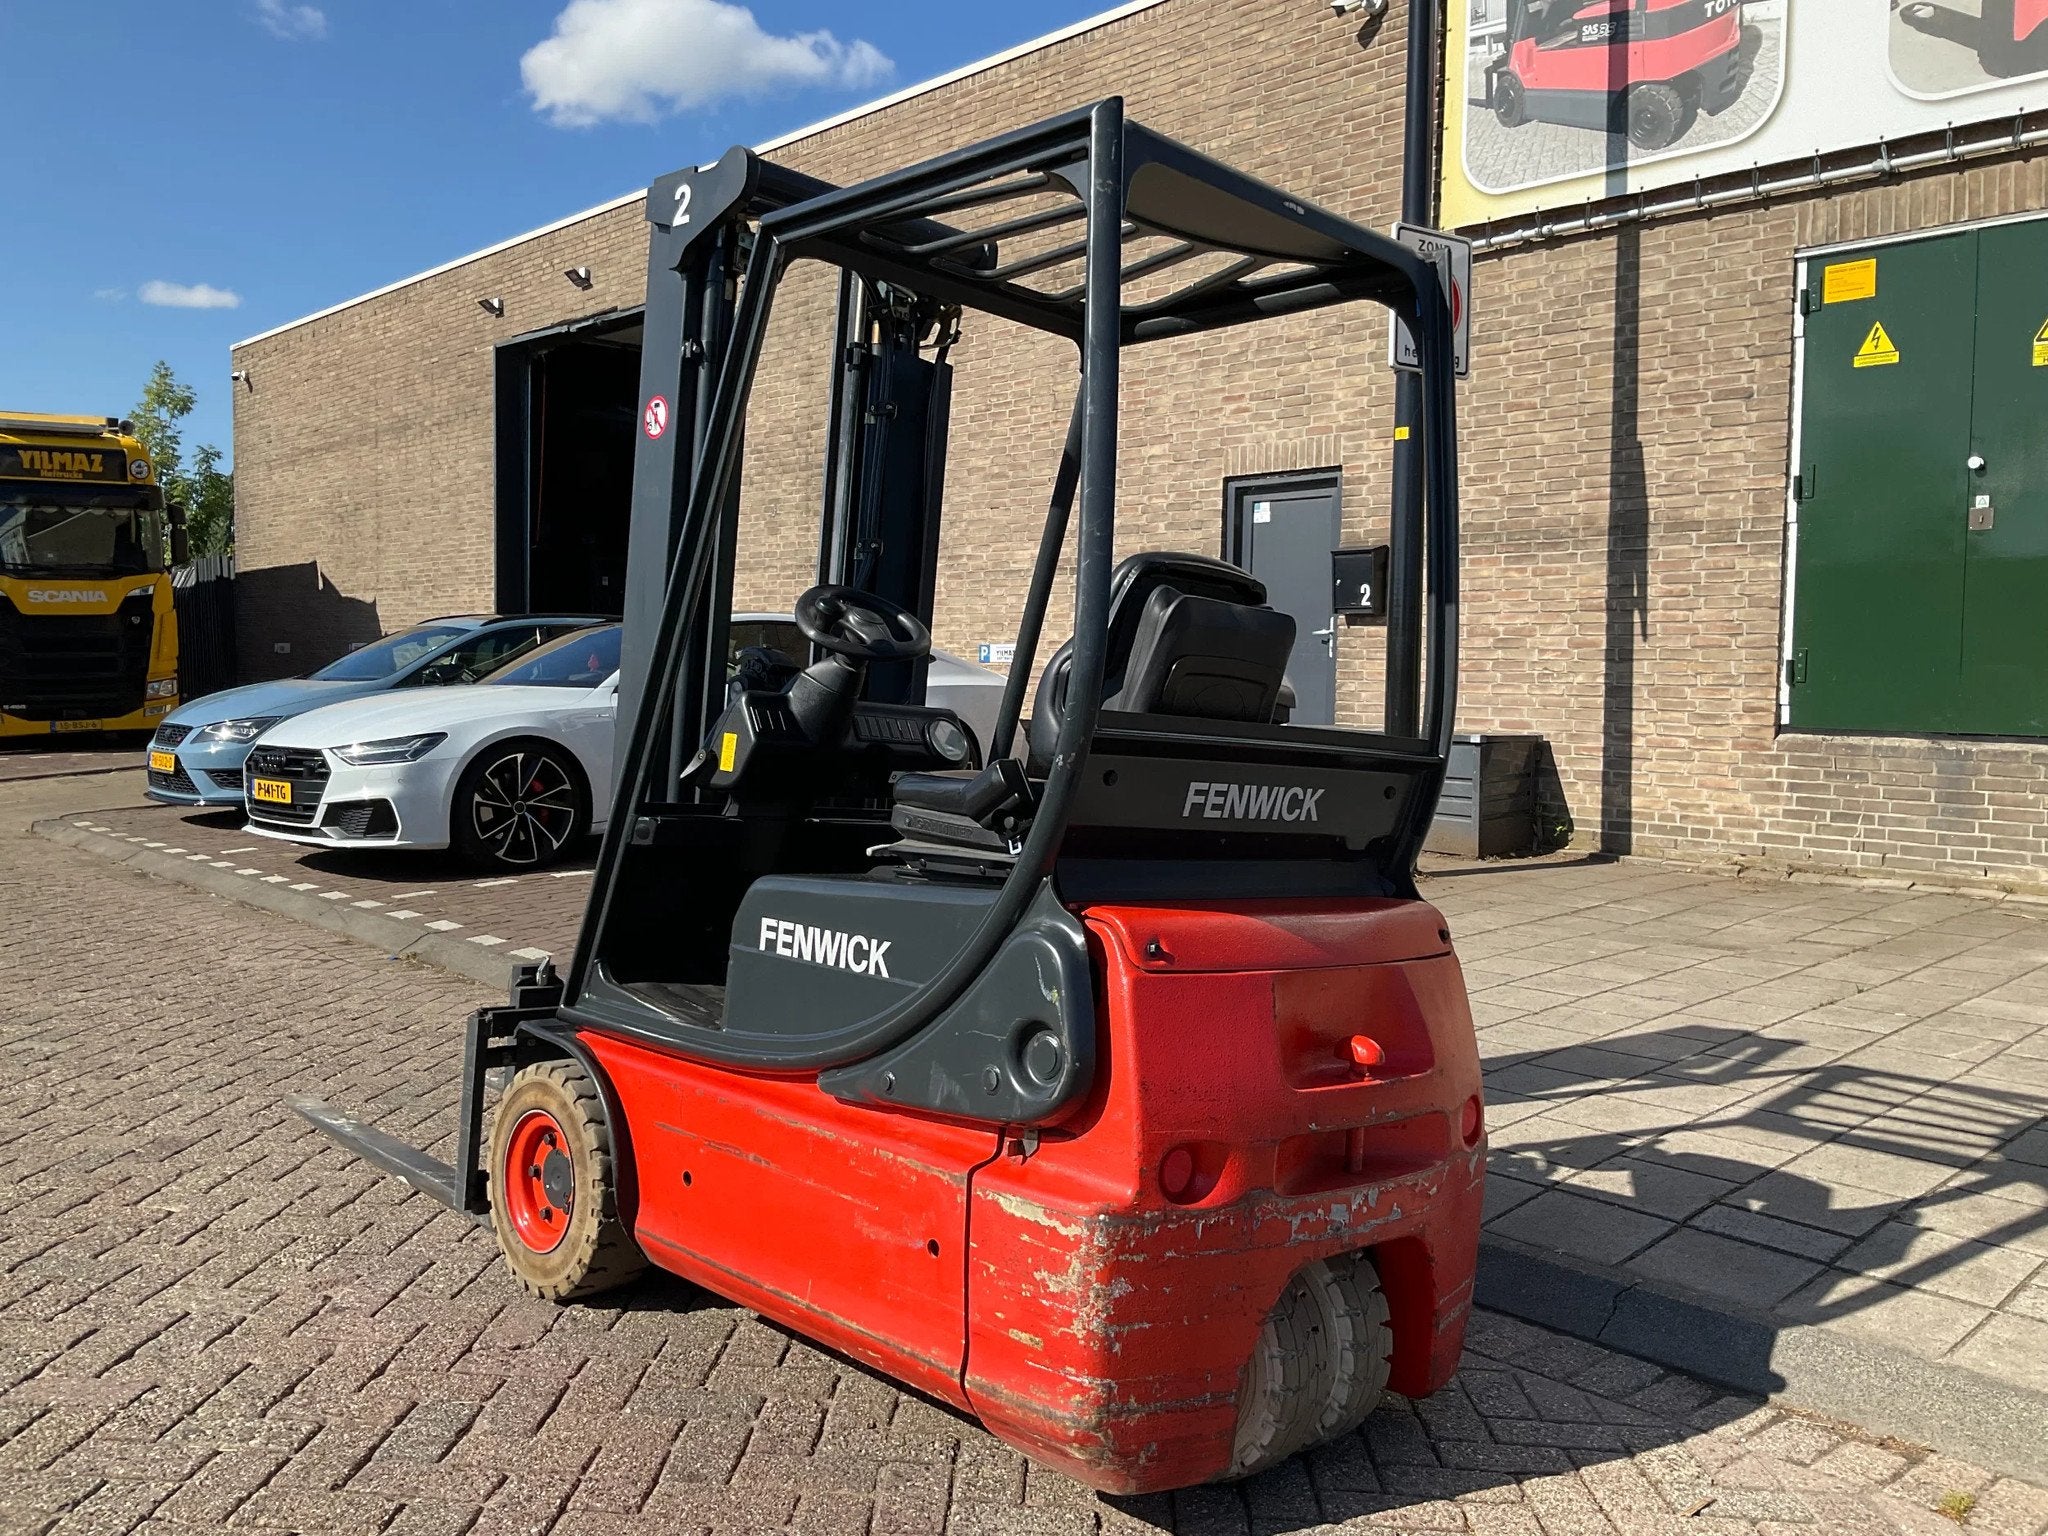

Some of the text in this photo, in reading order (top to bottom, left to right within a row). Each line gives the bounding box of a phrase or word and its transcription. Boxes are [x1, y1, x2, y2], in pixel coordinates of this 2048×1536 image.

[672, 184, 691, 227] 2
[17, 450, 103, 473] YILMAZ
[28, 590, 108, 603] SCANIA
[1360, 584, 1371, 606] 2
[257, 782, 286, 800] P-141-TG
[1182, 782, 1326, 822] FENWICK
[759, 917, 892, 978] FENWICK
